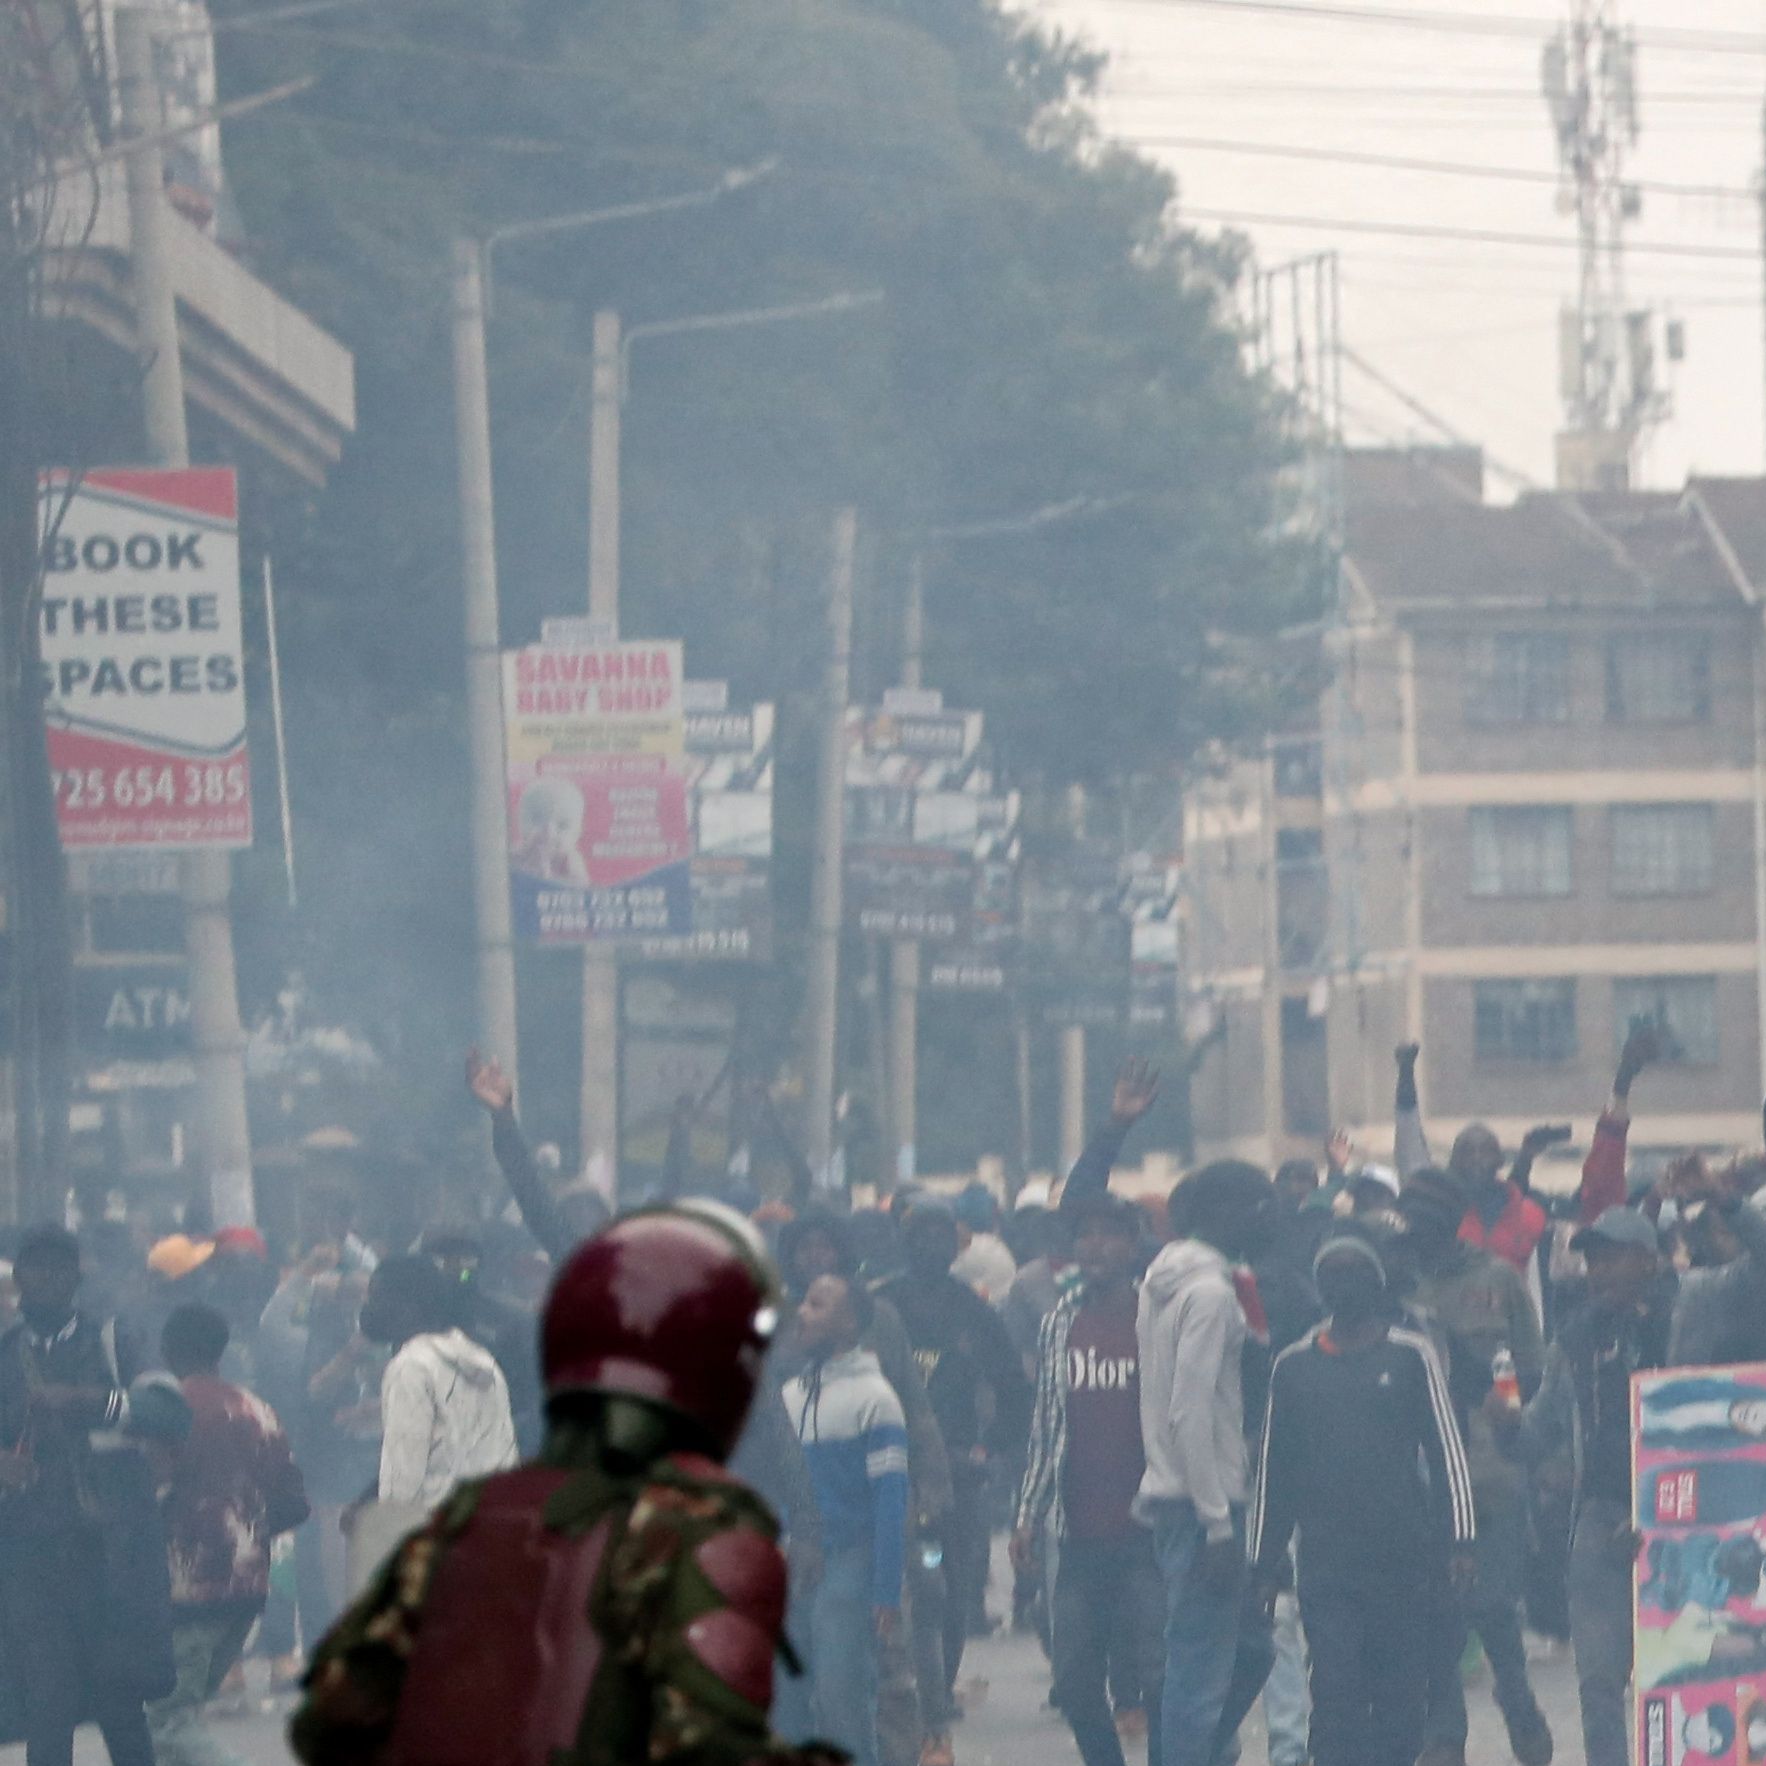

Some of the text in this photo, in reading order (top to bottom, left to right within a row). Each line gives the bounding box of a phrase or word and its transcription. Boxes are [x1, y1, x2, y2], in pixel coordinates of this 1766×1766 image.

[47, 532, 205, 573] BOOK
[43, 592, 220, 636] THESE
[113, 766, 175, 807] 654
[184, 764, 246, 805] 385
[104, 987, 193, 1028] ATM
[1066, 1346, 1136, 1391] Dior
